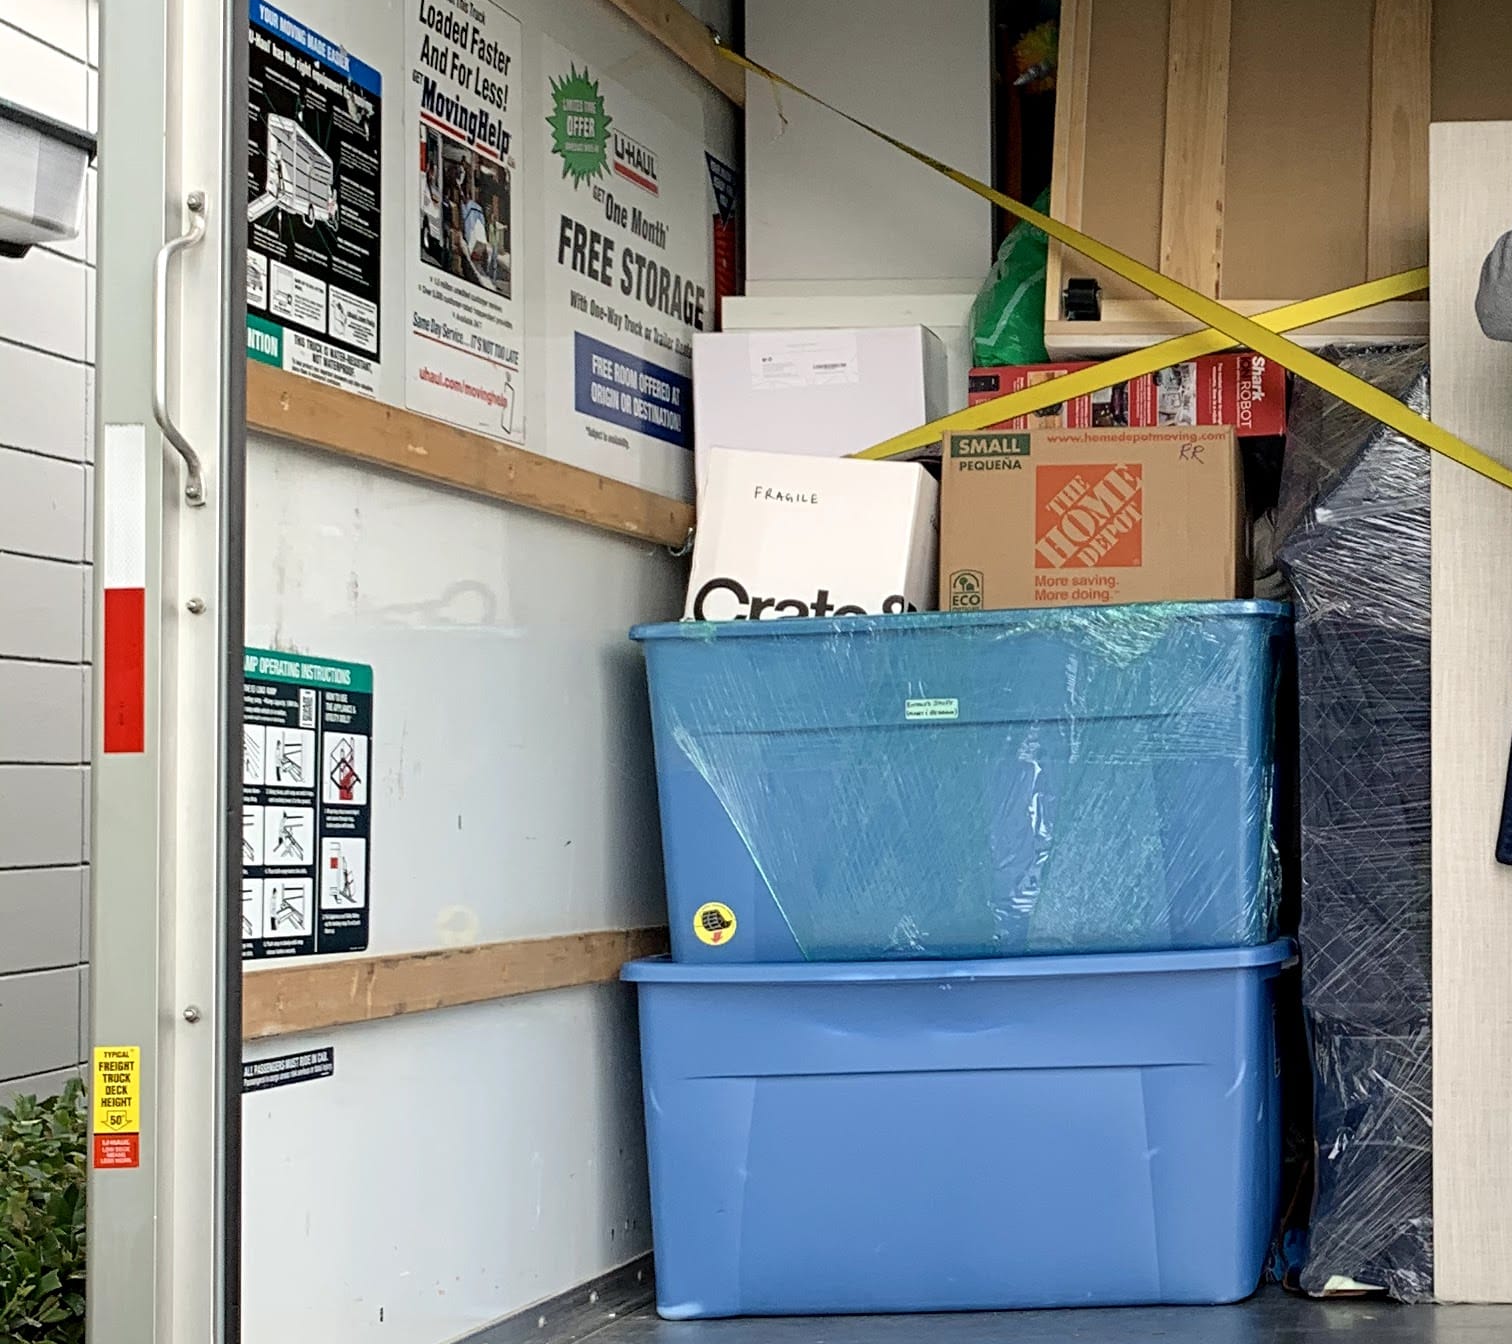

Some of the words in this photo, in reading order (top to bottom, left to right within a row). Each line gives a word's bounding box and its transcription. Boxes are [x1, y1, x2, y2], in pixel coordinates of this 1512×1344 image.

[470, 26, 511, 76] Faster
[420, 34, 449, 76] And
[450, 50, 473, 90] For
[474, 65, 509, 112] Less!
[421, 76, 510, 163] MovingHelp
[566, 115, 596, 137] OFFER
[614, 134, 658, 181] U-HAUL
[605, 194, 628, 229] One
[558, 214, 615, 288] FREE
[620, 247, 705, 331] STORAGE
[570, 289, 588, 313] With
[624, 314, 643, 338] Truck
[592, 354, 613, 381] FREE
[614, 363, 638, 390] ROOM
[639, 372, 671, 403] OFFERED
[671, 386, 681, 407] AT
[1252, 356, 1265, 402] Shark
[591, 381, 619, 410] ORIGIN
[620, 393, 632, 415] OR
[1240, 381, 1252, 428] ROBOT
[959, 438, 1020, 455] SMALL
[1047, 431, 1226, 445] www.homedepotmoving.com
[959, 456, 1022, 472] PEQUEÑA
[754, 486, 818, 504] FRAGILE
[1047, 474, 1091, 517] THE
[1035, 464, 1142, 568] HOME
[1076, 501, 1142, 568] DEPOT
[693, 577, 868, 622] Crat
[1035, 576, 1068, 587] More
[1072, 575, 1119, 590] saving.
[1035, 590, 1068, 601] More
[952, 596, 981, 606] ECO
[98, 1061, 135, 1072] FREIGHT
[102, 1073, 131, 1084] TRUCK
[101, 1097, 132, 1108] HEIGHT
[105, 1085, 128, 1095] DECK
